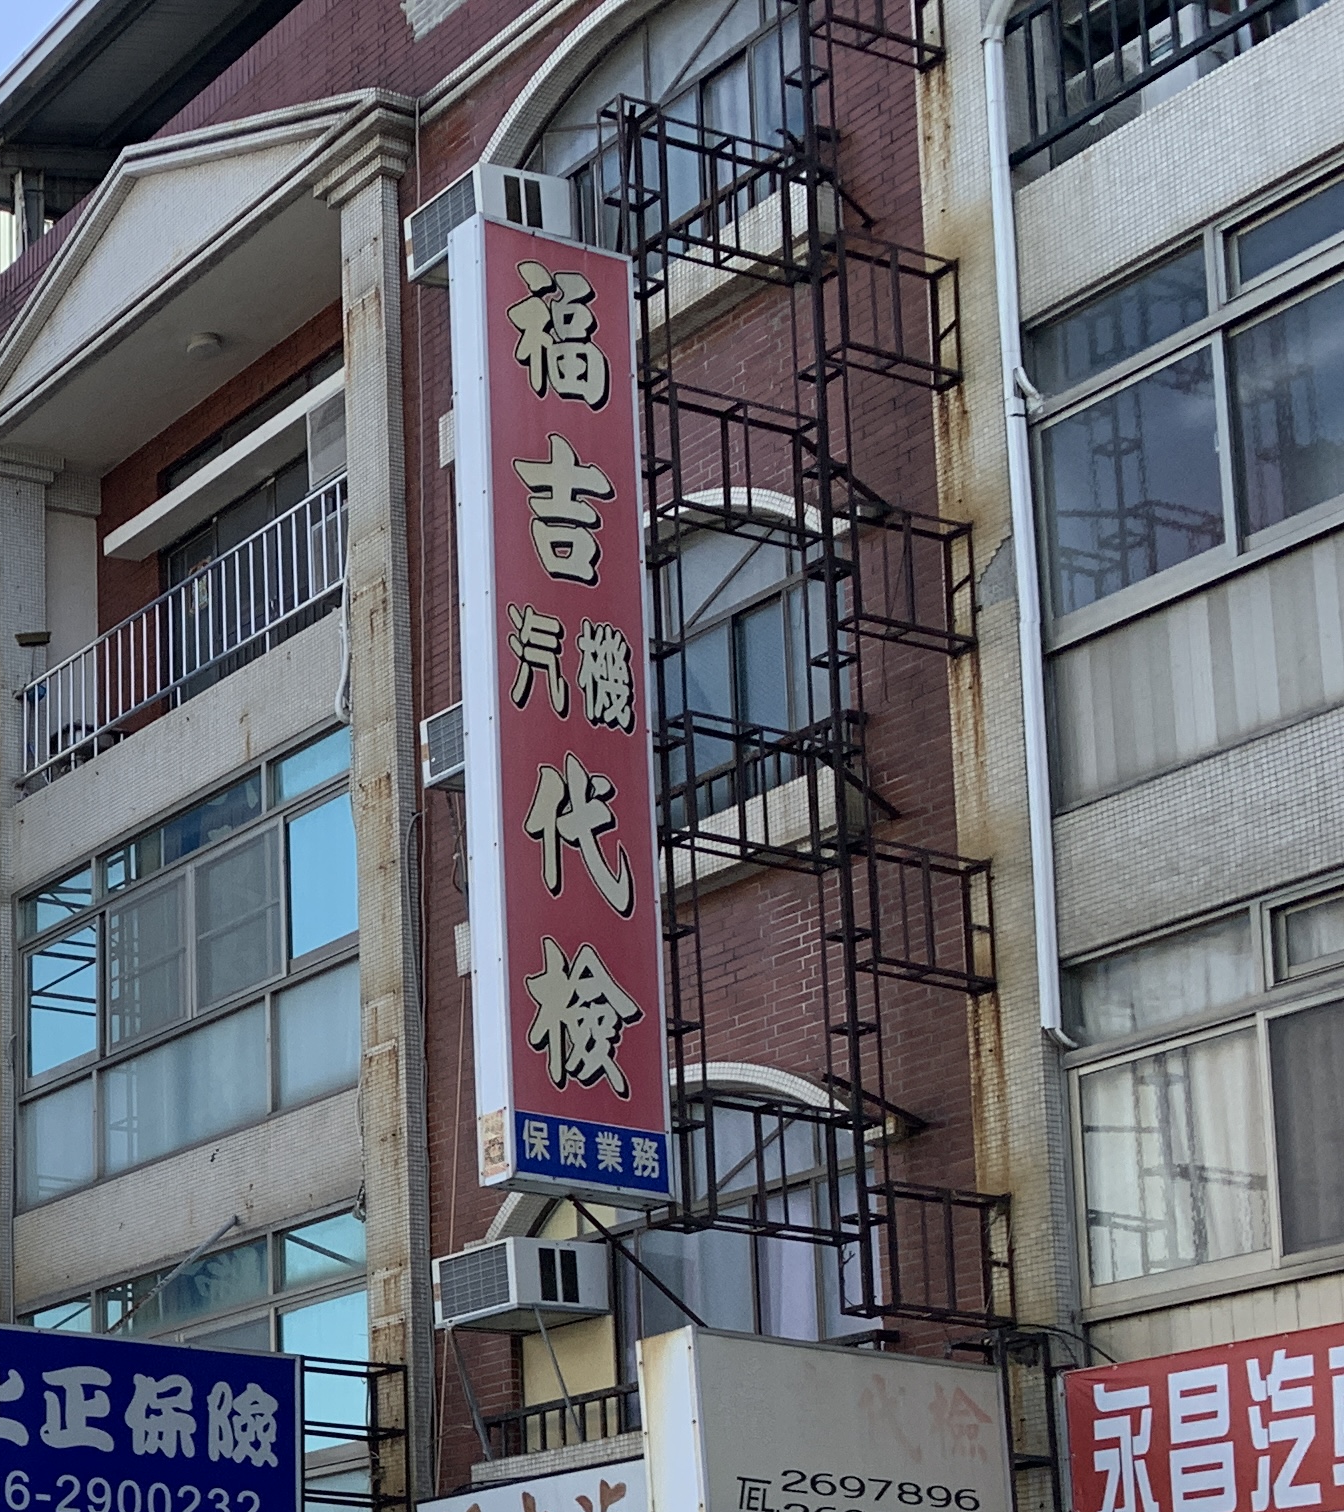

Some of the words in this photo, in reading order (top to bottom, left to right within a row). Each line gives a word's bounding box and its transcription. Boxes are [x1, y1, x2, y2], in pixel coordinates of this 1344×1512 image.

[523, 1119, 661, 1180] 保險業務
[781, 1469, 980, 1512] 2697896
